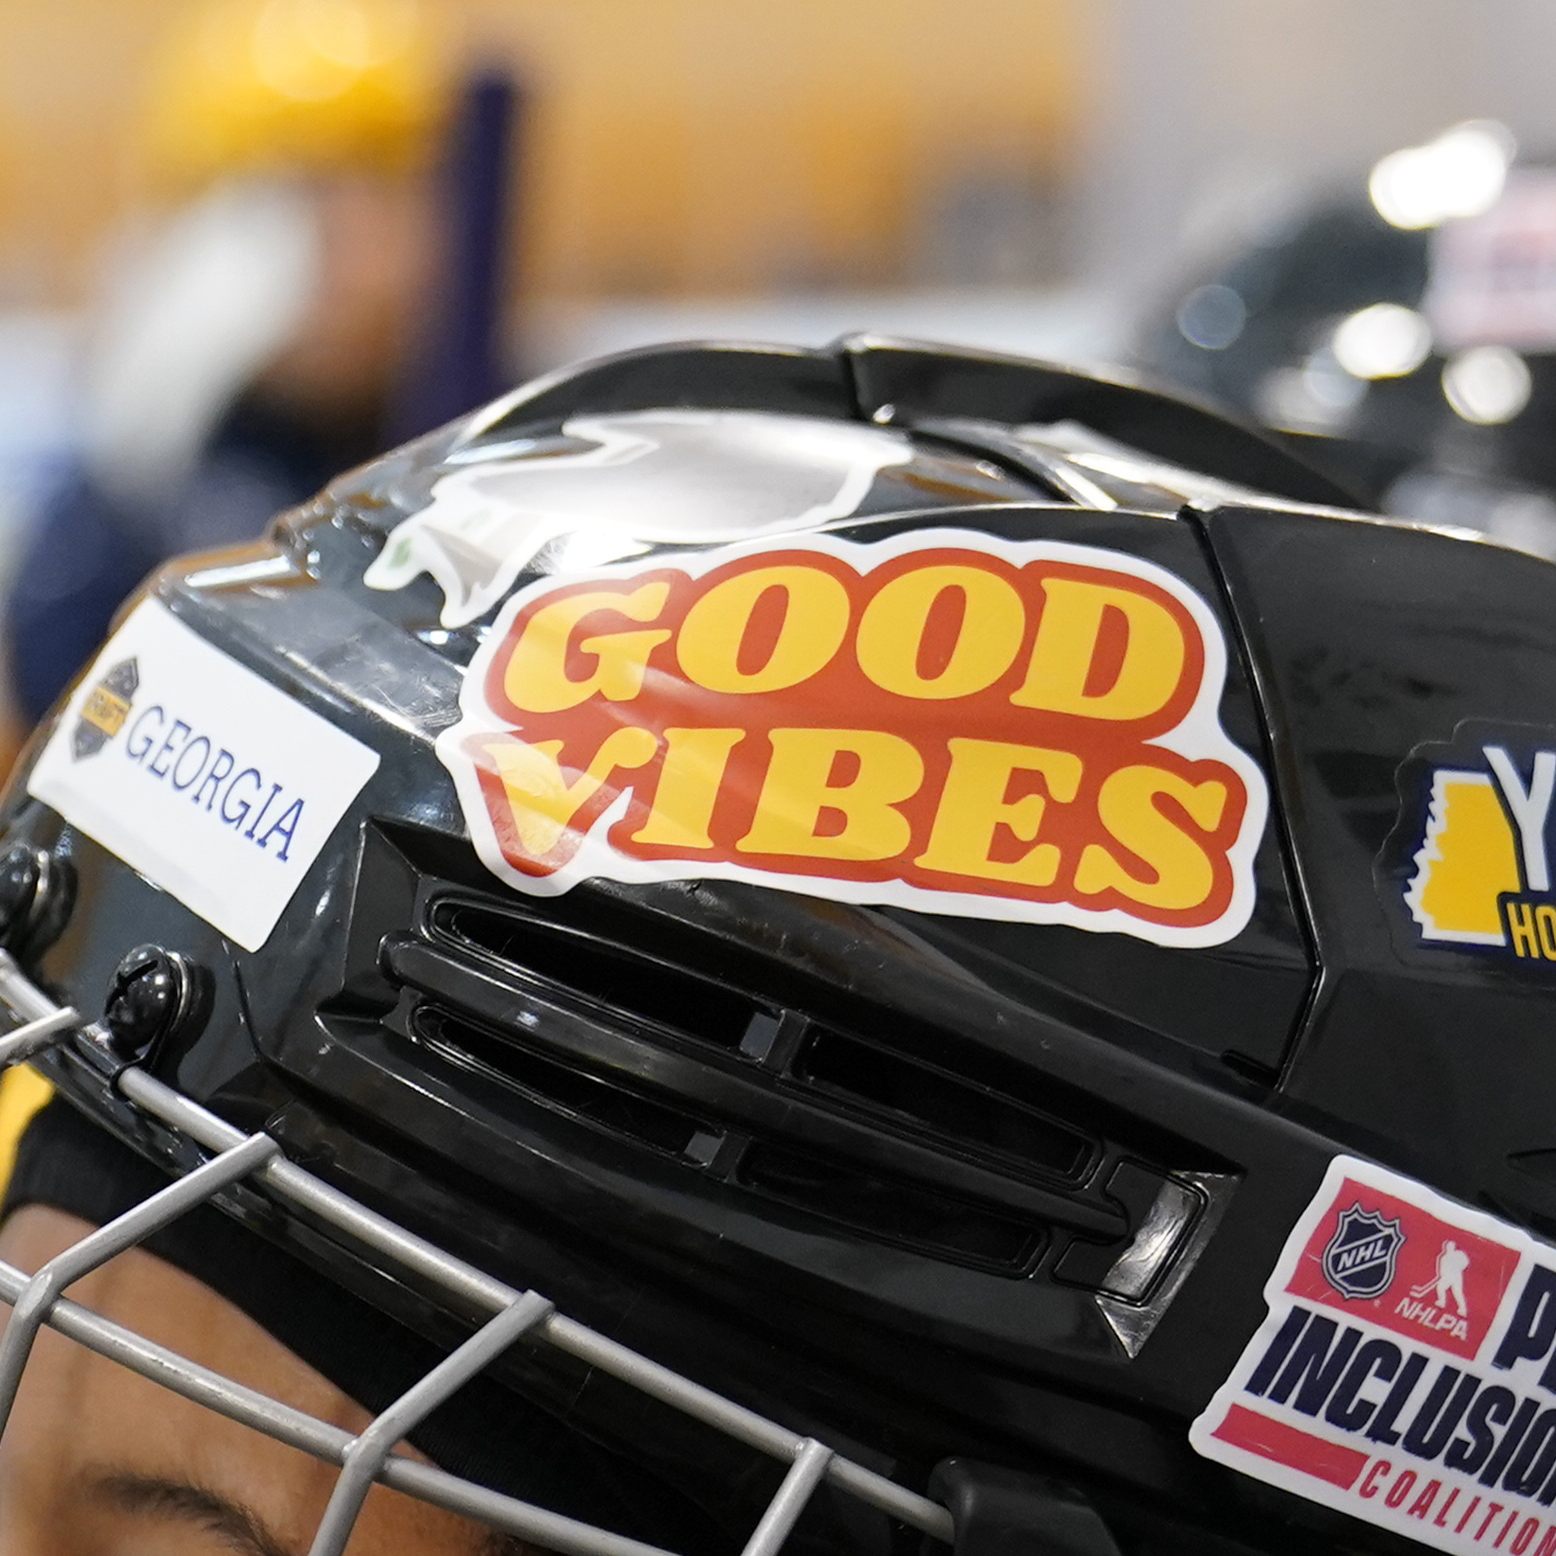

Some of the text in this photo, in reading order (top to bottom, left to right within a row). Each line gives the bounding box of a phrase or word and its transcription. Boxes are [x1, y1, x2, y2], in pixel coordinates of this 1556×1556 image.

[503, 564, 1185, 722] GOOD
[126, 704, 305, 863] GEORGIA
[483, 726, 1227, 911] VIBES
[1336, 1239, 1387, 1272] NHL
[1394, 1297, 1468, 1341] NHLPA
